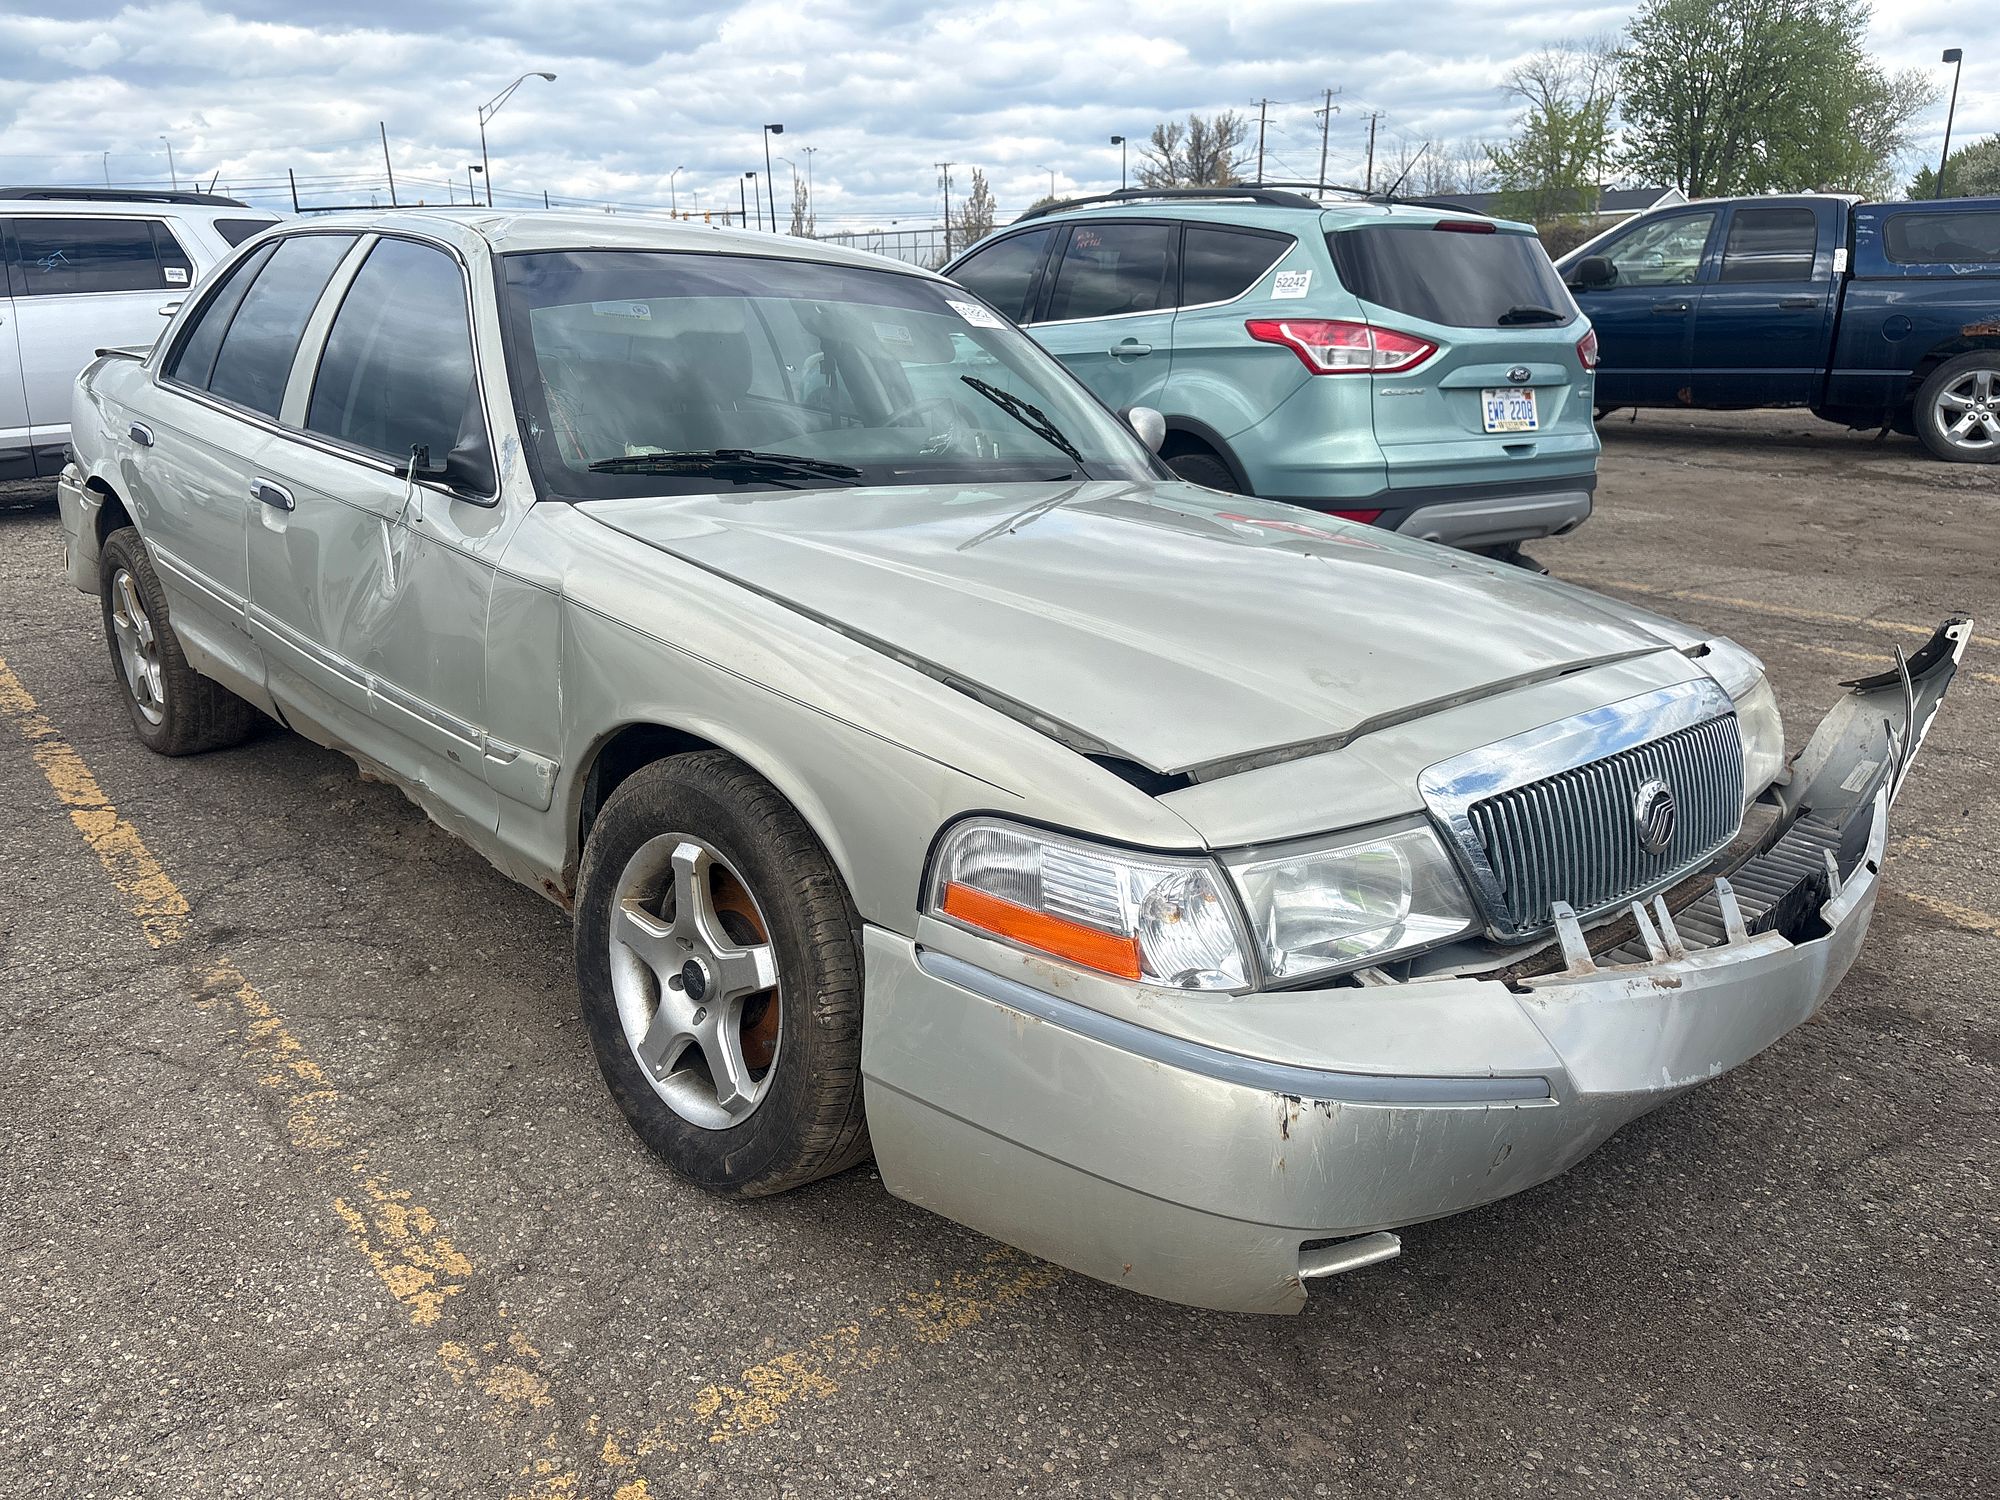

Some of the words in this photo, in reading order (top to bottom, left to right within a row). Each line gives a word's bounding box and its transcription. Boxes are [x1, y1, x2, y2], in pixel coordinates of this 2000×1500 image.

[1275, 276, 1307, 289] 52242
[1487, 401, 1505, 421] EWR
[1509, 400, 1533, 420] 2208
